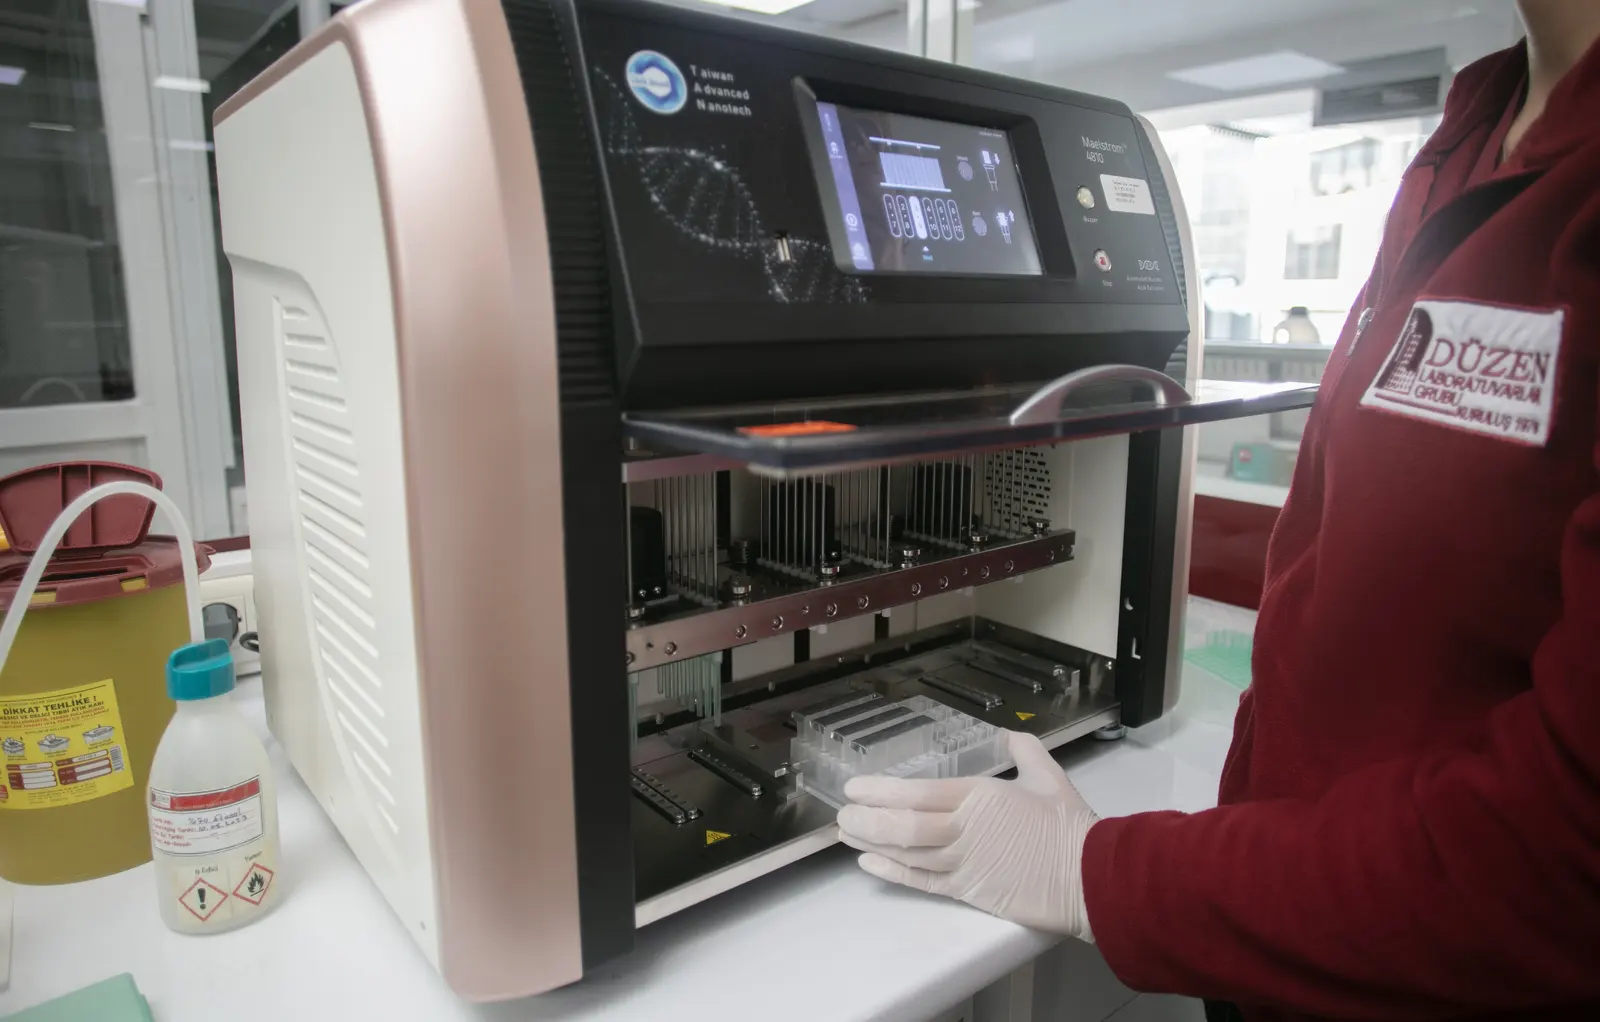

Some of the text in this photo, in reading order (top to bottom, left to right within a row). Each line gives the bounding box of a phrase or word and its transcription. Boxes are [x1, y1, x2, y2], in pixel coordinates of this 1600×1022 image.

[690, 64, 734, 82] Taiwan
[694, 82, 750, 100] Advanced
[697, 99, 752, 116] Nanotech
[1082, 136, 1124, 153] Maelstrom
[1086, 151, 1104, 163] 4810
[1425, 336, 1551, 384] DÜZEN
[1414, 384, 1463, 406] GRUBU
[3, 706, 41, 715] DİKKAT
[44, 697, 91, 711] TEHLİKE
